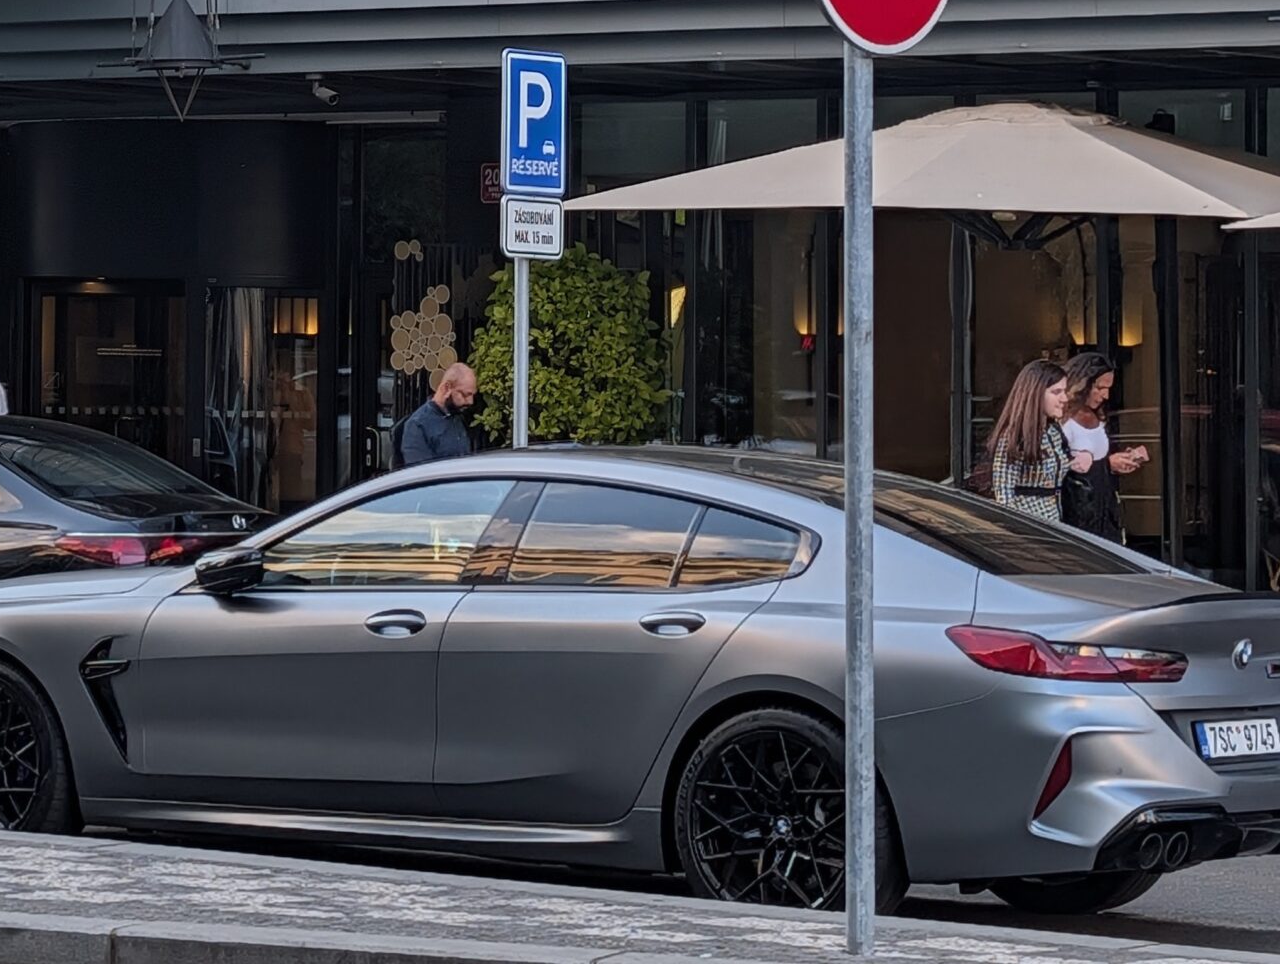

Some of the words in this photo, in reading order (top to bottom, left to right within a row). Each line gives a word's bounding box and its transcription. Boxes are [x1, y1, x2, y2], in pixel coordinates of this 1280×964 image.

[518, 70, 553, 148] P
[511, 155, 559, 177] RÉSERVÉ
[514, 208, 554, 226] ZÁSOBOVÁNÍ
[514, 230, 530, 244] MAX.
[532, 231, 540, 245] 15
[541, 233, 554, 245] min
[1209, 725, 1237, 755] 7SC
[1243, 723, 1275, 752] 9745
